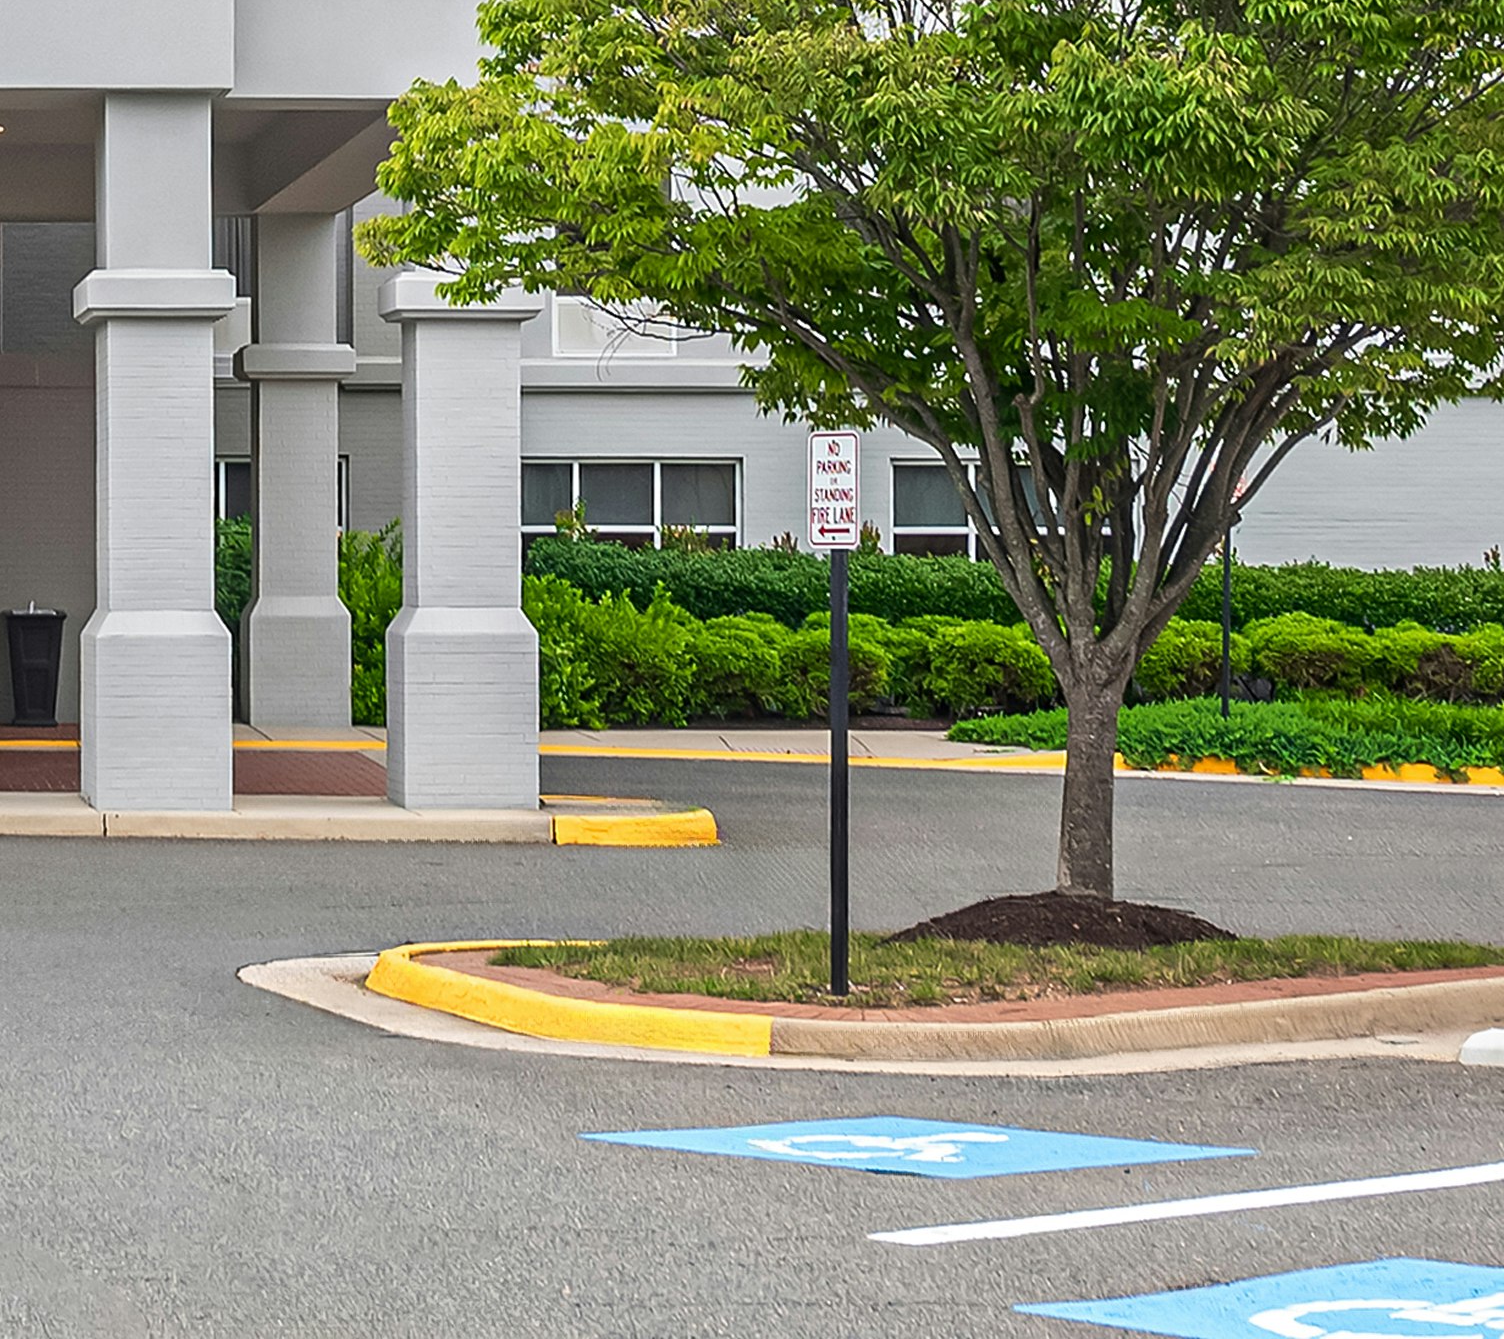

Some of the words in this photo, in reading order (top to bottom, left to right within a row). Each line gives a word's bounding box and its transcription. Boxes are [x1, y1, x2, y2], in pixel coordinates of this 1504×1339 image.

[828, 440, 841, 456] NO
[816, 460, 852, 474] PARKING
[814, 488, 854, 502] STANDING
[812, 506, 830, 524] FIRE
[833, 506, 856, 524] LANE
